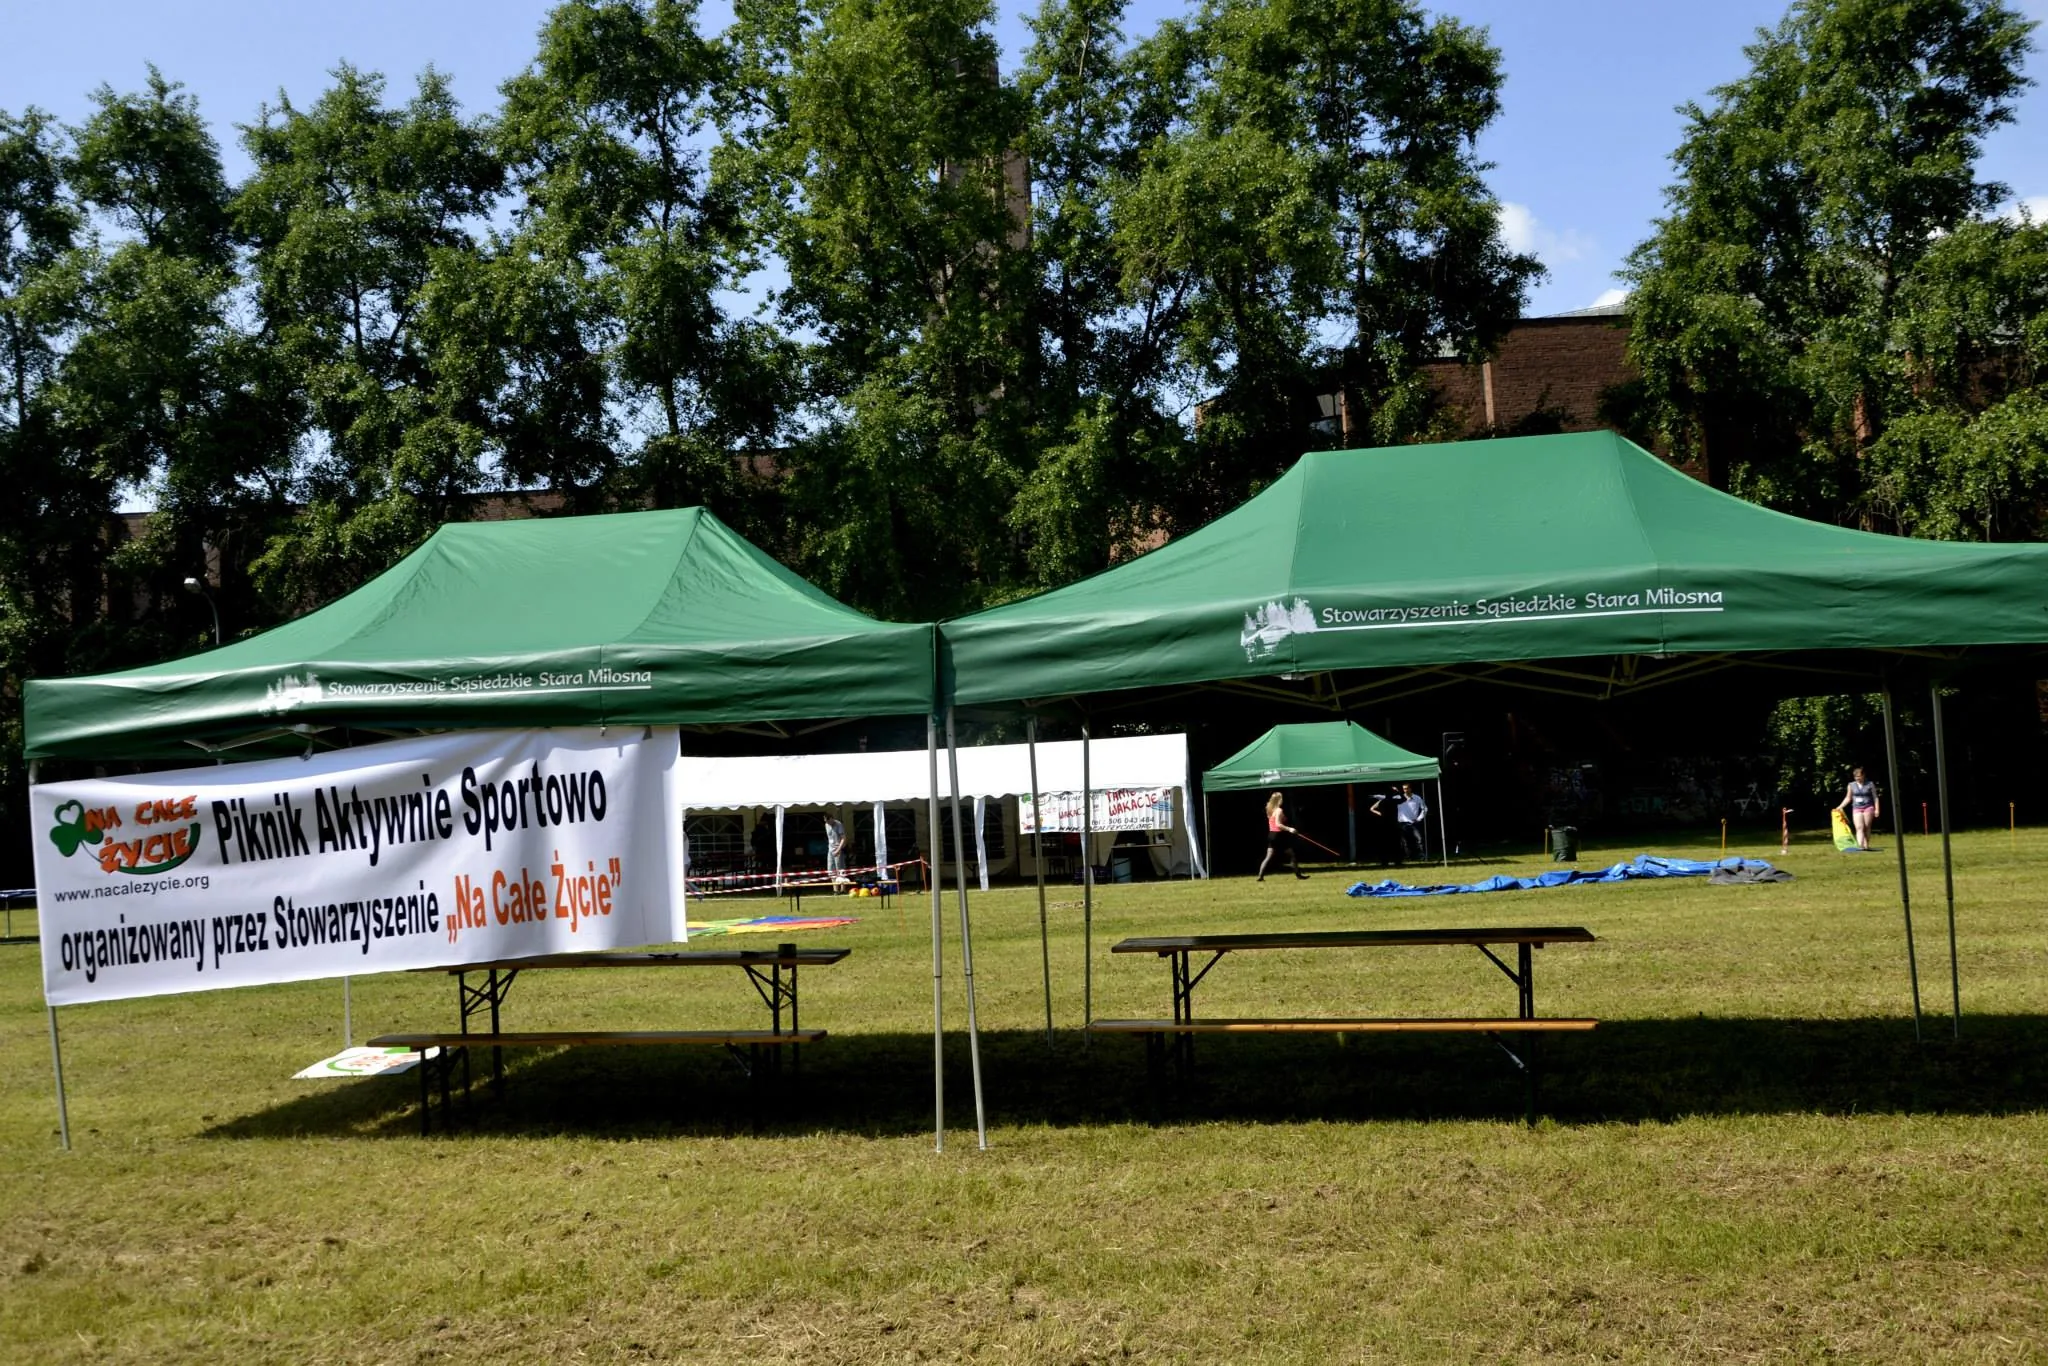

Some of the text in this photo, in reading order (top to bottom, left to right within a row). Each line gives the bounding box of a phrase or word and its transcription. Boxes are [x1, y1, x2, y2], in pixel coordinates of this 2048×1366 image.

[1321, 602, 1470, 625] Stowarzyszenie
[1475, 593, 1577, 618] Sąsiedzkie
[1584, 591, 1640, 609] Stara
[327, 677, 447, 696] Stowarzyszenie
[450, 674, 533, 693] Sąsiedzkie
[539, 671, 584, 687] Stara
[85, 805, 122, 832] NA
[212, 760, 607, 866] Piknik Aktywnie Sportowo
[1108, 793, 1159, 817] WAKACJE
[99, 828, 191, 873] ŻYCIE
[54, 874, 210, 903] www.nacalezycie.org
[61, 914, 205, 983] organizowany
[213, 911, 269, 969] przez
[273, 880, 440, 955] Stowarzyszenie
[492, 868, 548, 926] Całe
